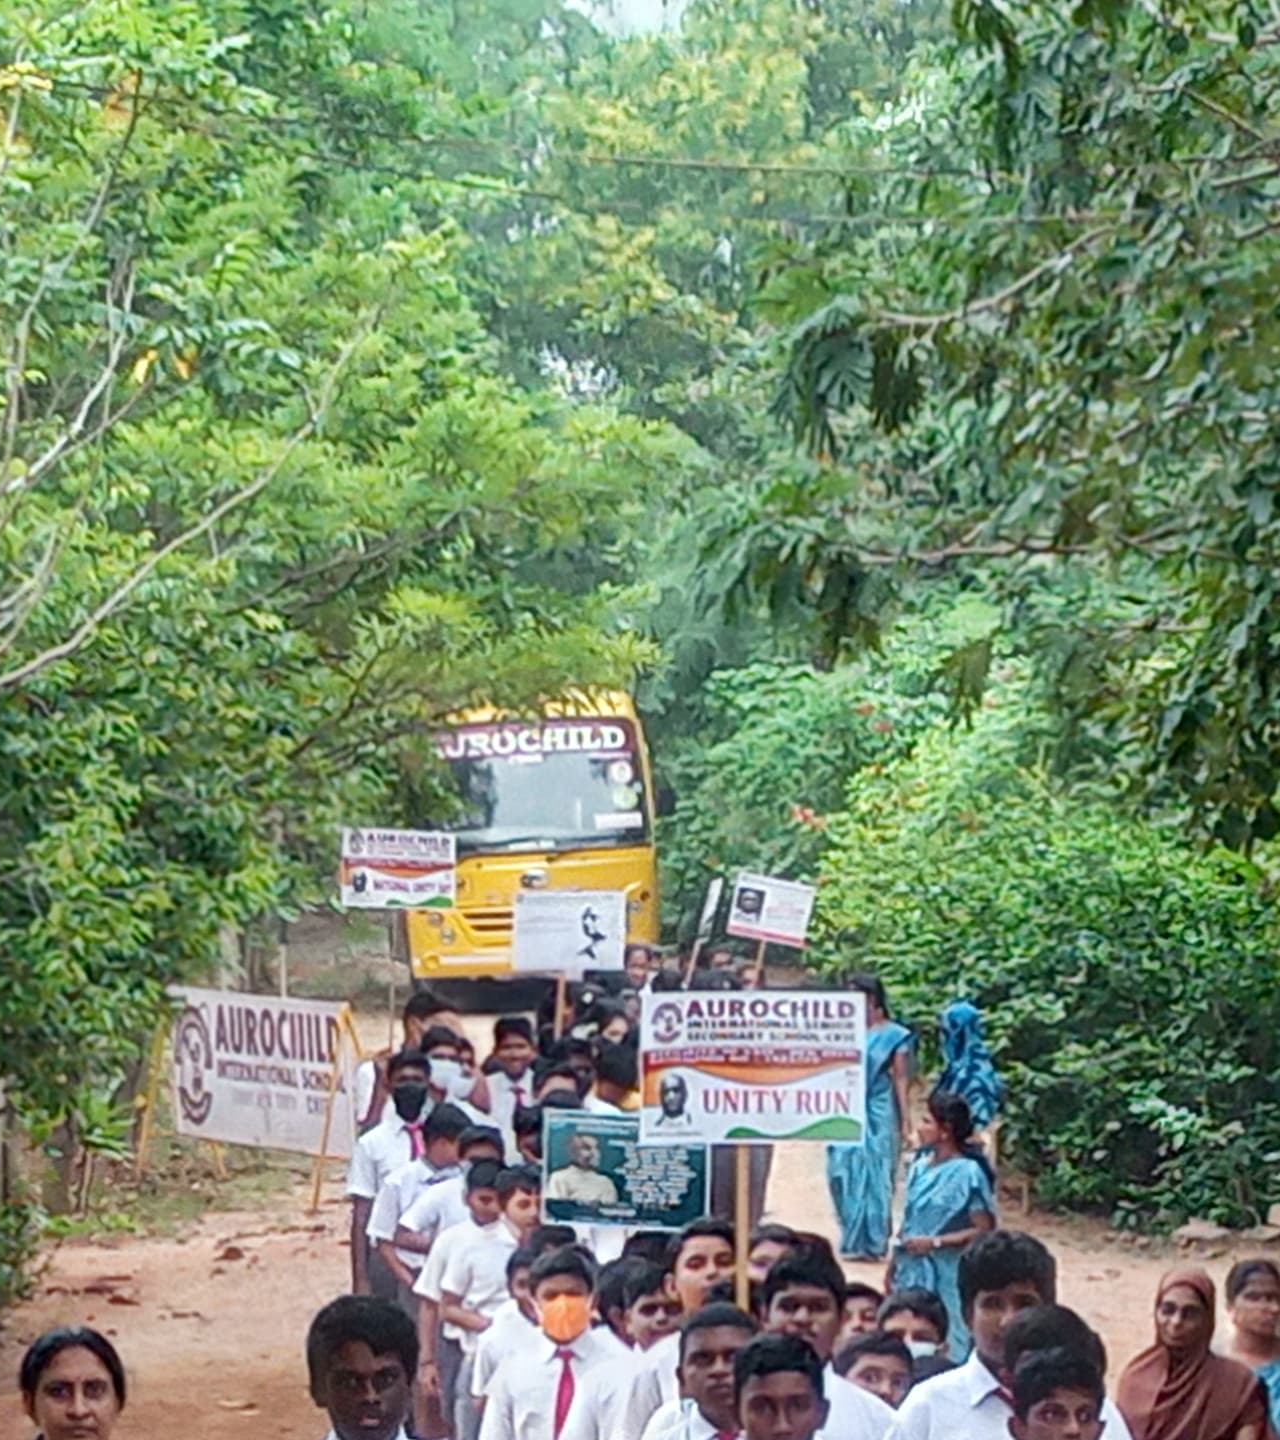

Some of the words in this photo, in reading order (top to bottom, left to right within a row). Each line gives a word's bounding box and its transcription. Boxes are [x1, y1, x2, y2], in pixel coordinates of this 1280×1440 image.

[436, 725, 627, 759] UROCHILD
[686, 1000, 856, 1019] AUROCHILD
[217, 1004, 341, 1063] AUROCHILD
[703, 1090, 786, 1115] UNITY
[797, 1091, 851, 1115] RUN
